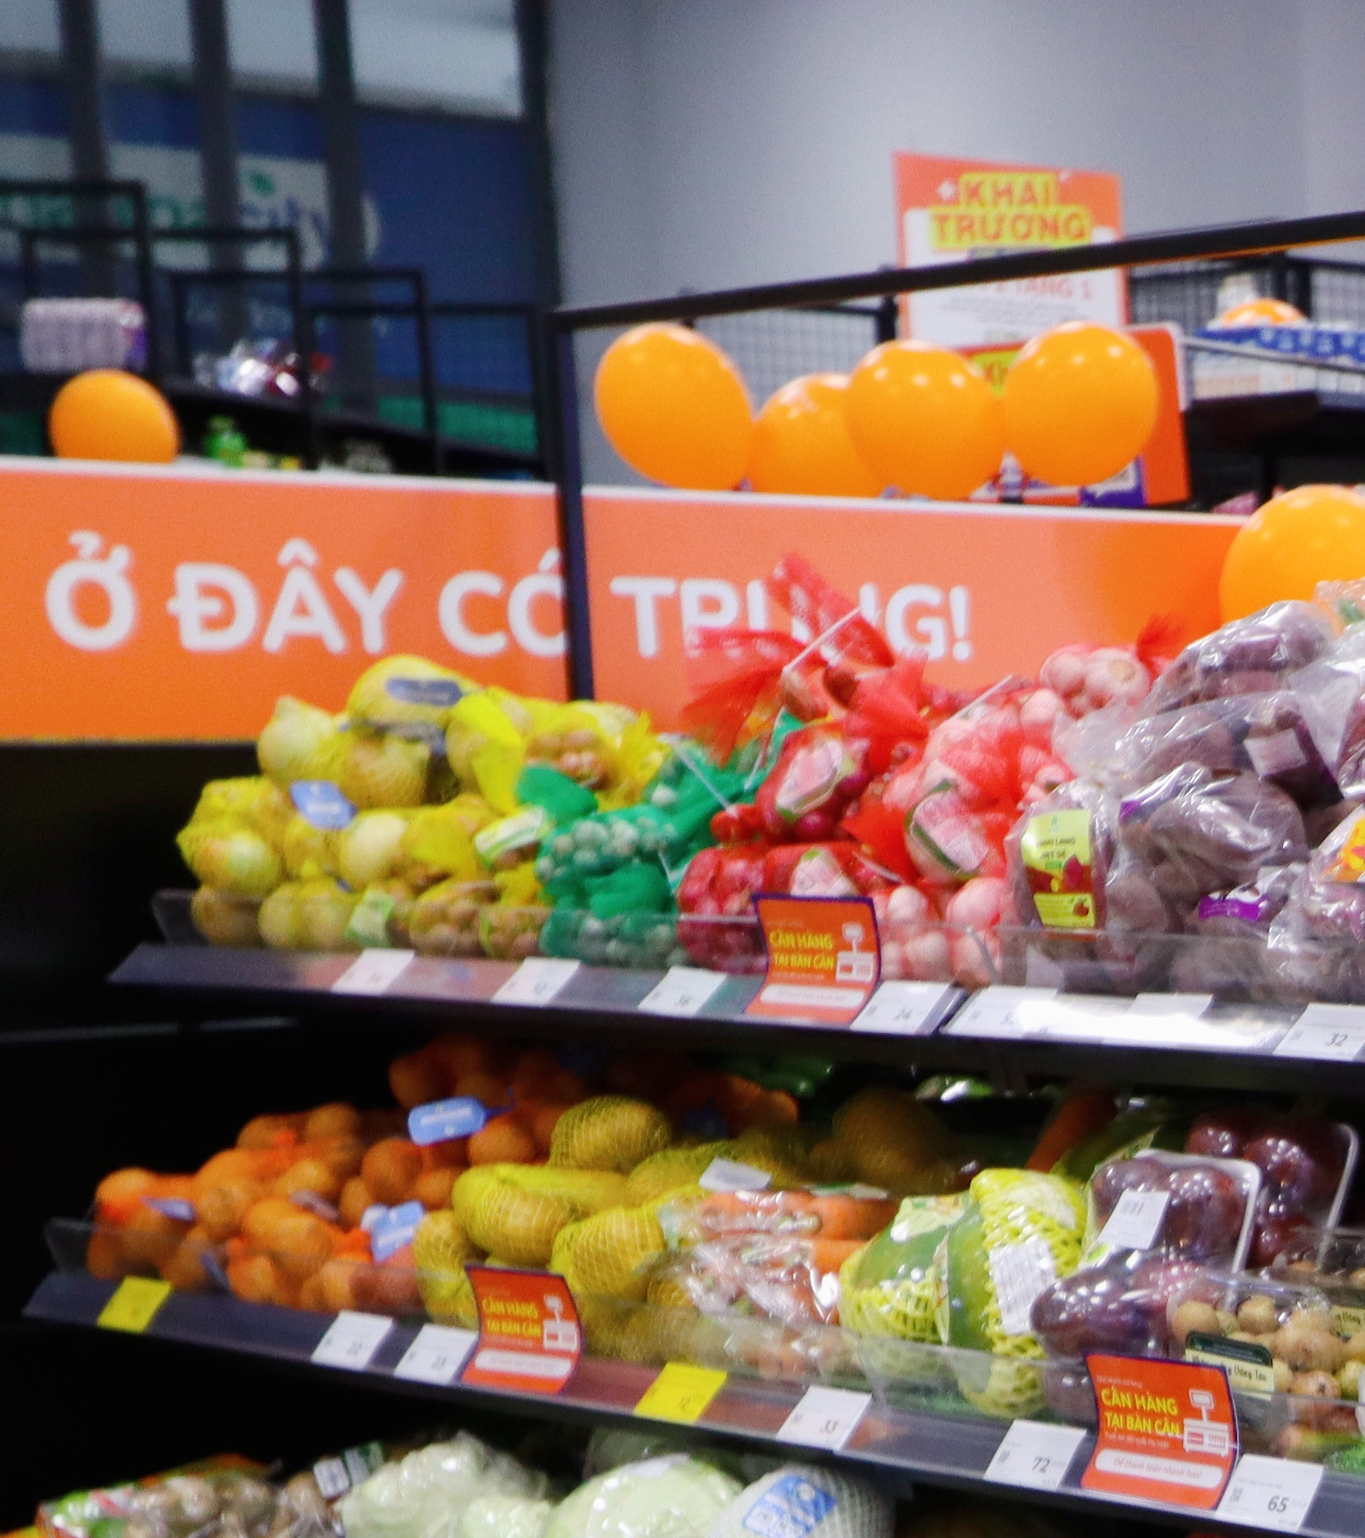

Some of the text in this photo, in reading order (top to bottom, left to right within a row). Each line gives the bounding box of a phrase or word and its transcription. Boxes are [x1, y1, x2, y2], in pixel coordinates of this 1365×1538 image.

[964, 180, 1055, 206] KHAI
[45, 531, 137, 652] Ở
[168, 537, 405, 656] ĐÂY
[437, 547, 566, 657] CÓ
[1324, 1032, 1348, 1047] 32
[1101, 1385, 1179, 1416] CÂN HÀNG
[1154, 1416, 1181, 1438] CÂN
[1031, 1456, 1051, 1474] 72
[1267, 1495, 1290, 1513] 65
